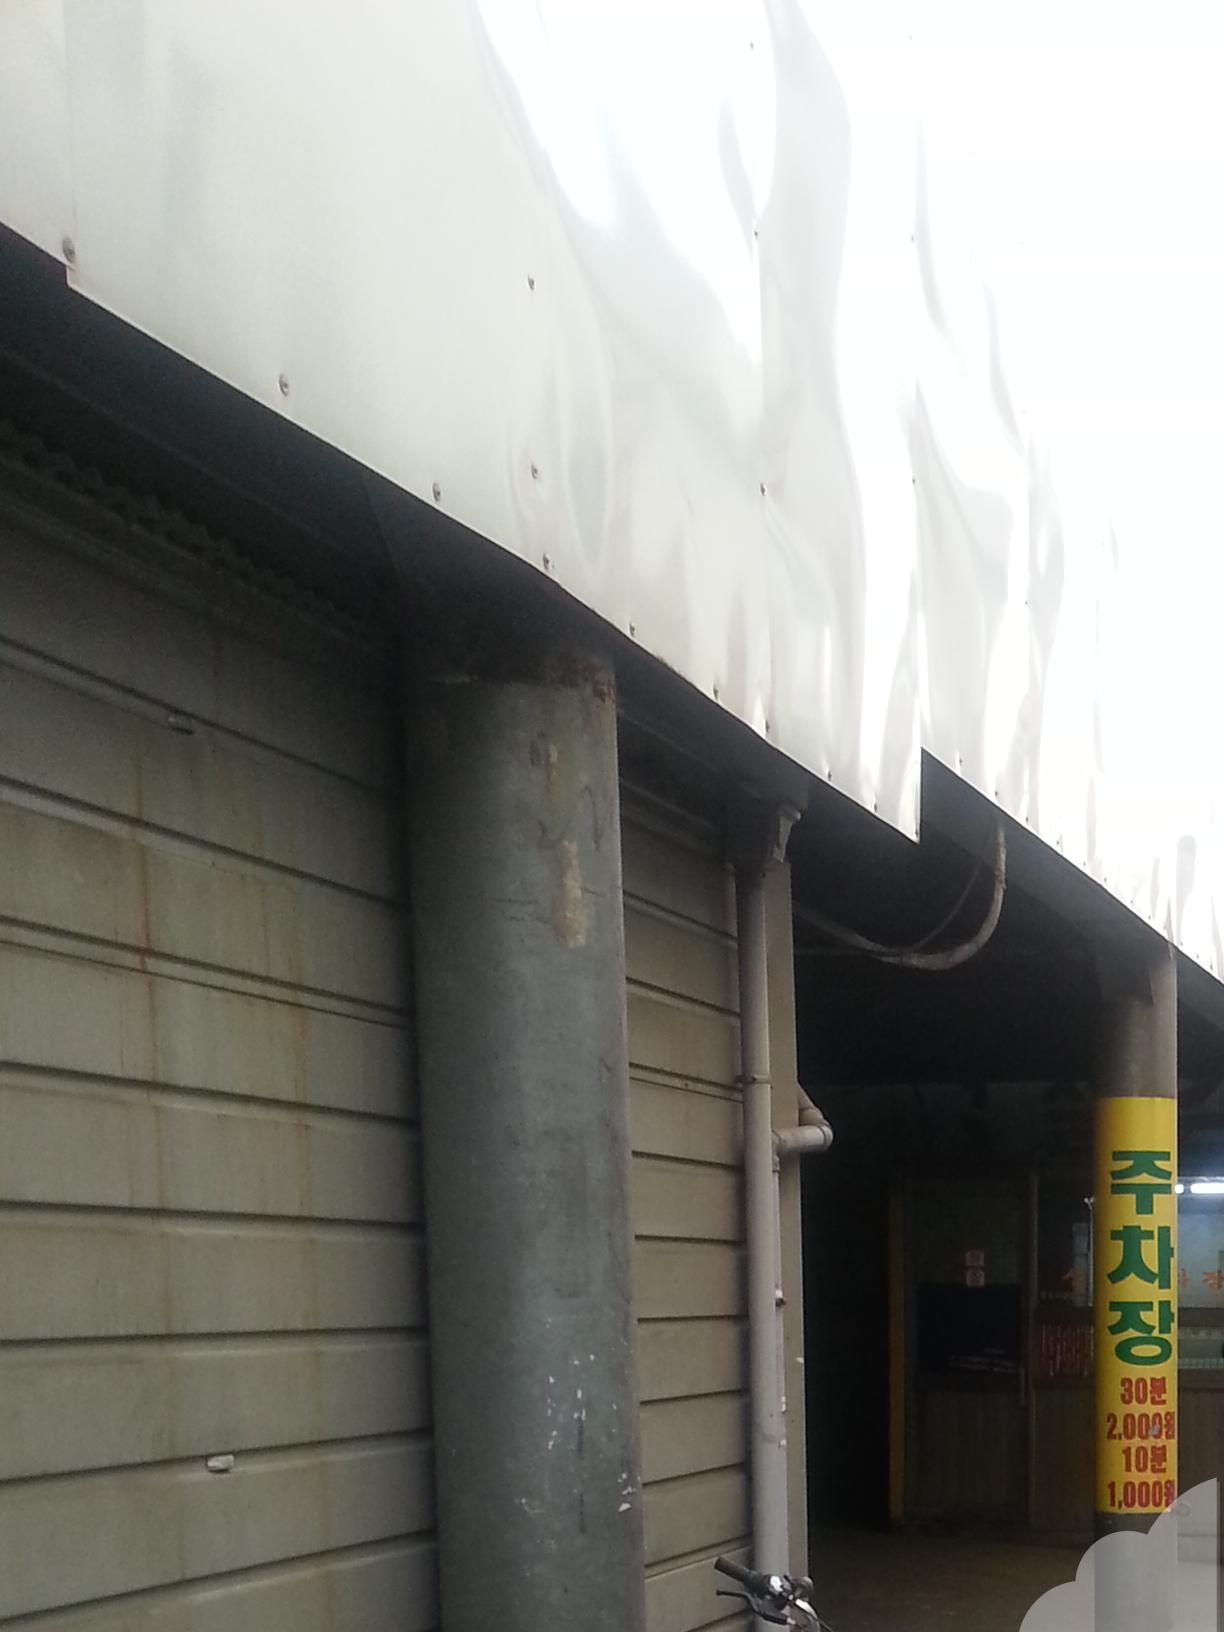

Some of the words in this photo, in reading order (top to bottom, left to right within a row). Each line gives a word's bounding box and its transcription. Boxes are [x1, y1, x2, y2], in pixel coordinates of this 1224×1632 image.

[1106, 1149, 1176, 1366] 주차장
[1120, 1376, 1167, 1405] 30분
[1106, 1411, 1175, 1440] 2,000원
[1121, 1445, 1167, 1473] 10분
